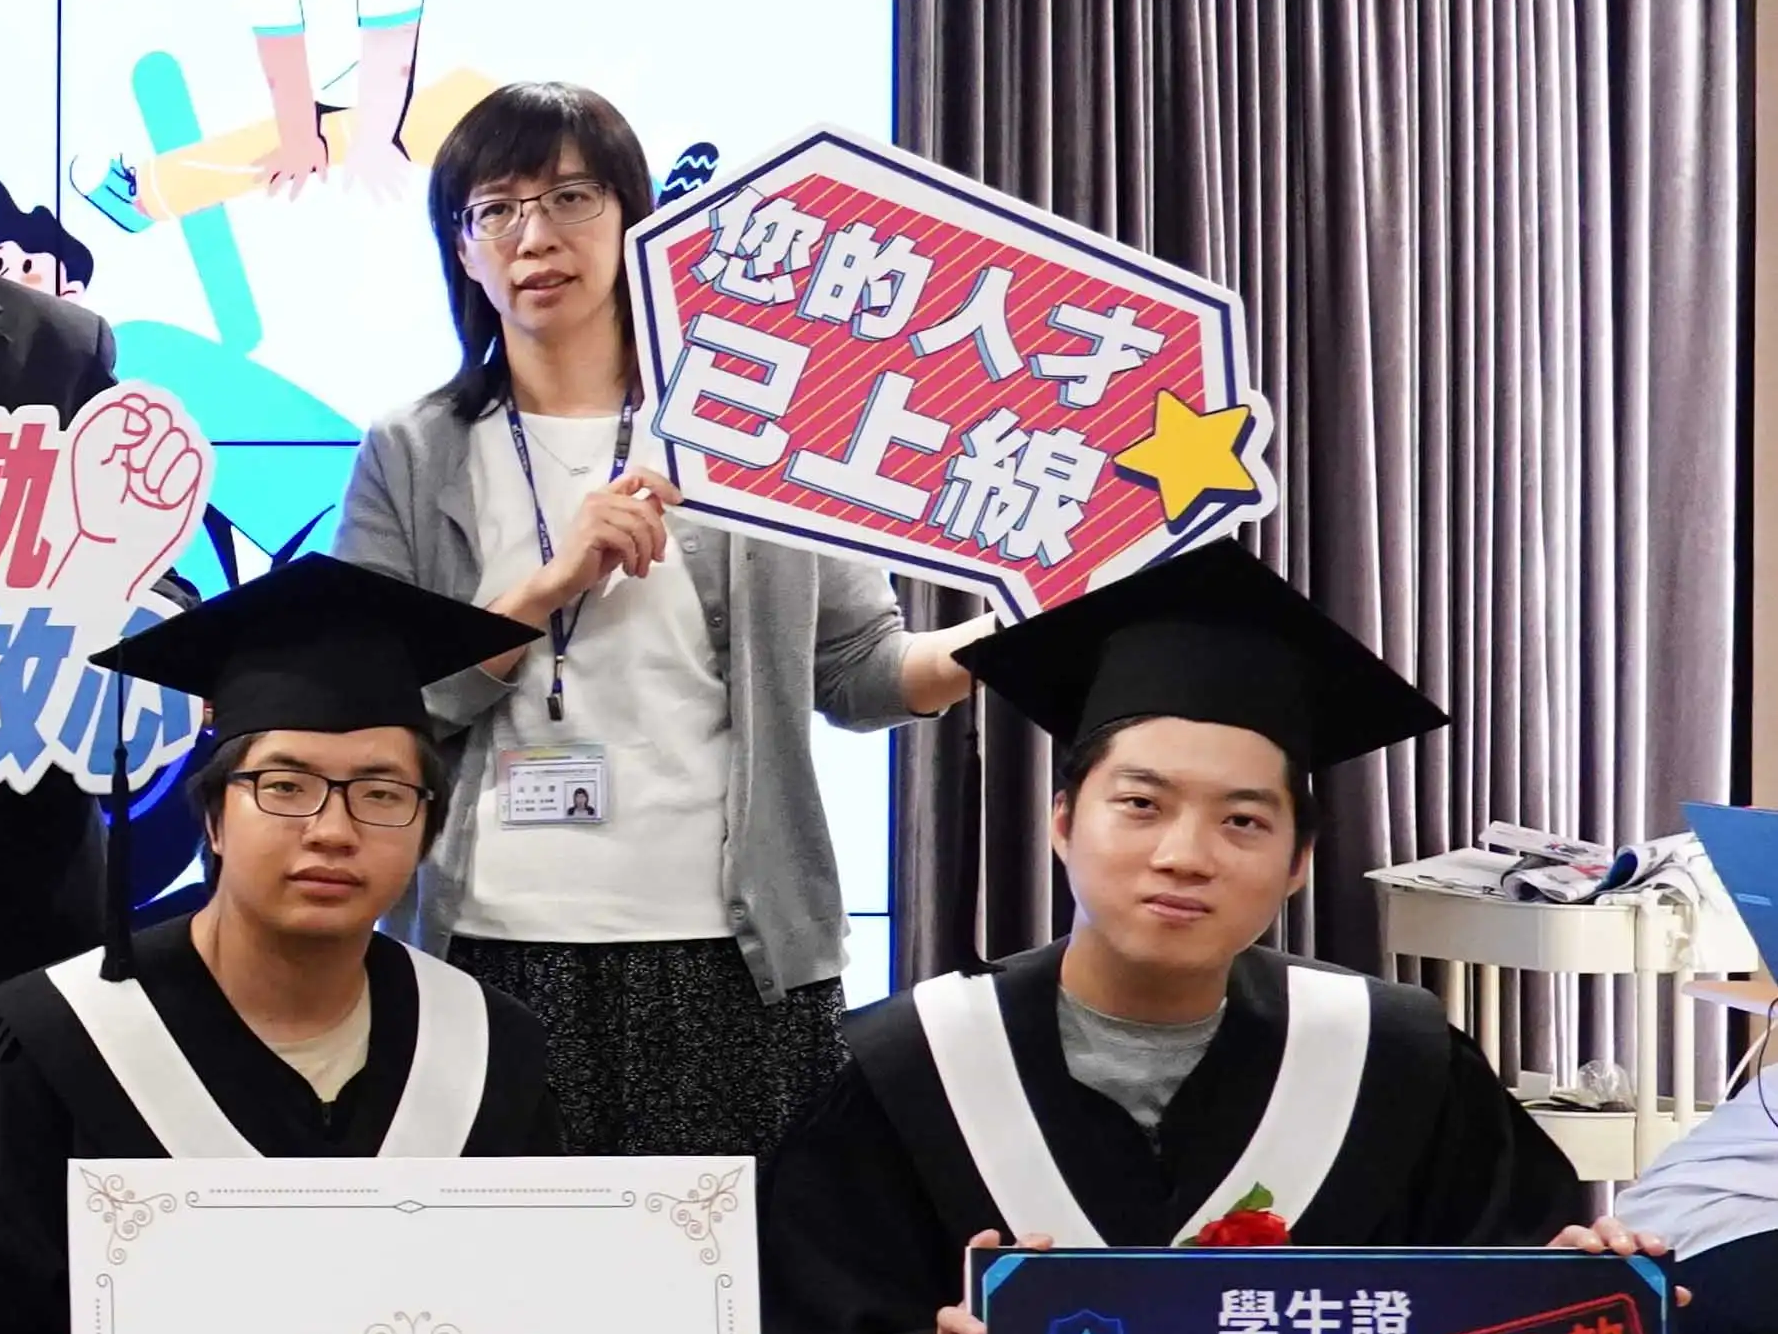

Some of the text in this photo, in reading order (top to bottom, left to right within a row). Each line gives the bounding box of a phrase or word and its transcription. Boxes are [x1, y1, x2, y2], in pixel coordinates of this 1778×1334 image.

[690, 187, 1166, 409] 您的人才
[651, 313, 1107, 567] 已上線
